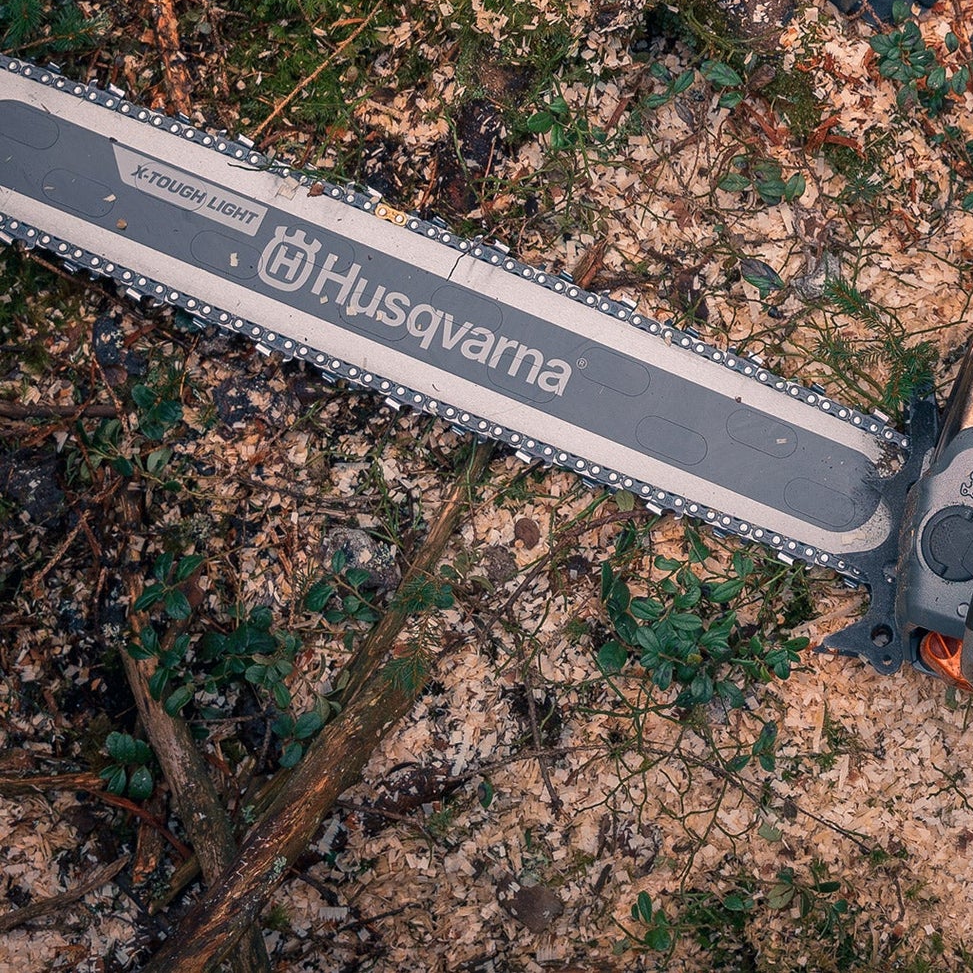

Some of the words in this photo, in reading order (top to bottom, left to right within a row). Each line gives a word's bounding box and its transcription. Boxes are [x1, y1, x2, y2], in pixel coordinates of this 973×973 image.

[131, 165, 207, 204] X-TOUGH
[206, 196, 259, 224] LIGHT
[310, 252, 574, 397] Husqvarna
